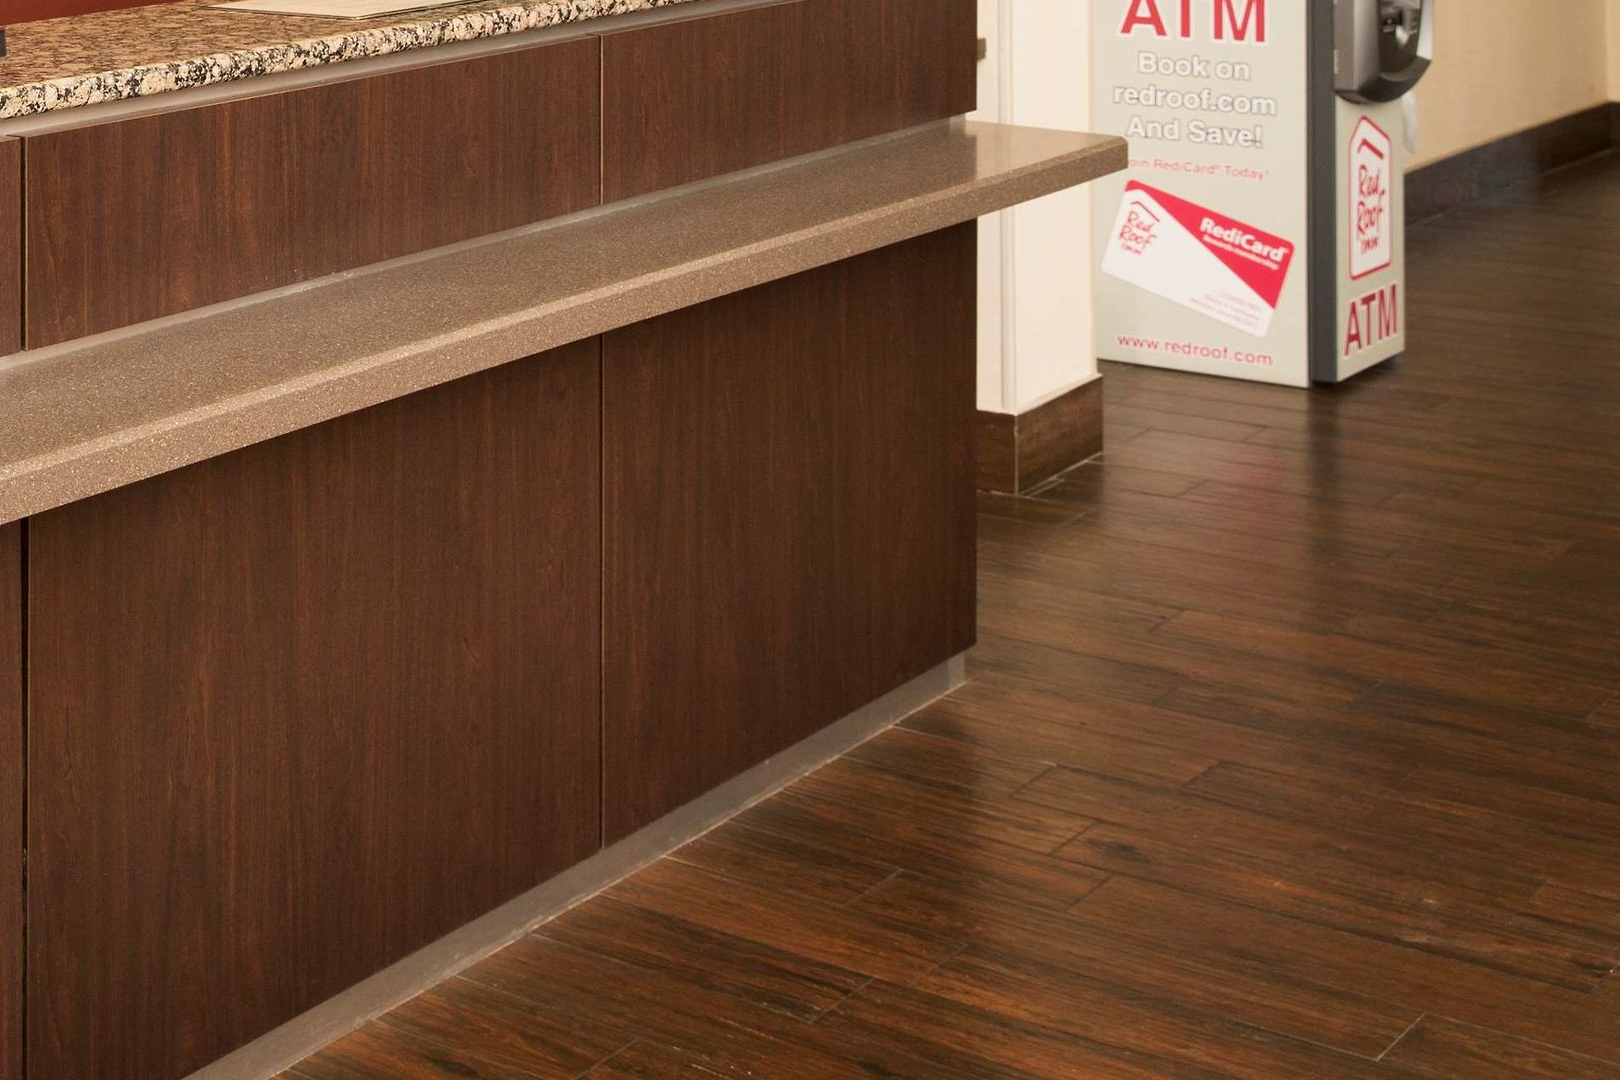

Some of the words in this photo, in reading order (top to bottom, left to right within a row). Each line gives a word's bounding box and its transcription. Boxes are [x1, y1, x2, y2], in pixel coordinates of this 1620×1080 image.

[1137, 50, 1209, 78] Book
[1214, 59, 1251, 81] on
[1112, 83, 1277, 117] redroof.com
[1126, 116, 1180, 141] And
[1187, 119, 1264, 149] Save!
[1128, 158, 1149, 168] oin
[1118, 224, 1159, 251] Roof
[1127, 210, 1155, 233] Red
[1199, 216, 1287, 262] RediCard
[1343, 283, 1399, 357] ATM
[1116, 334, 1274, 367] www.redroof.com
